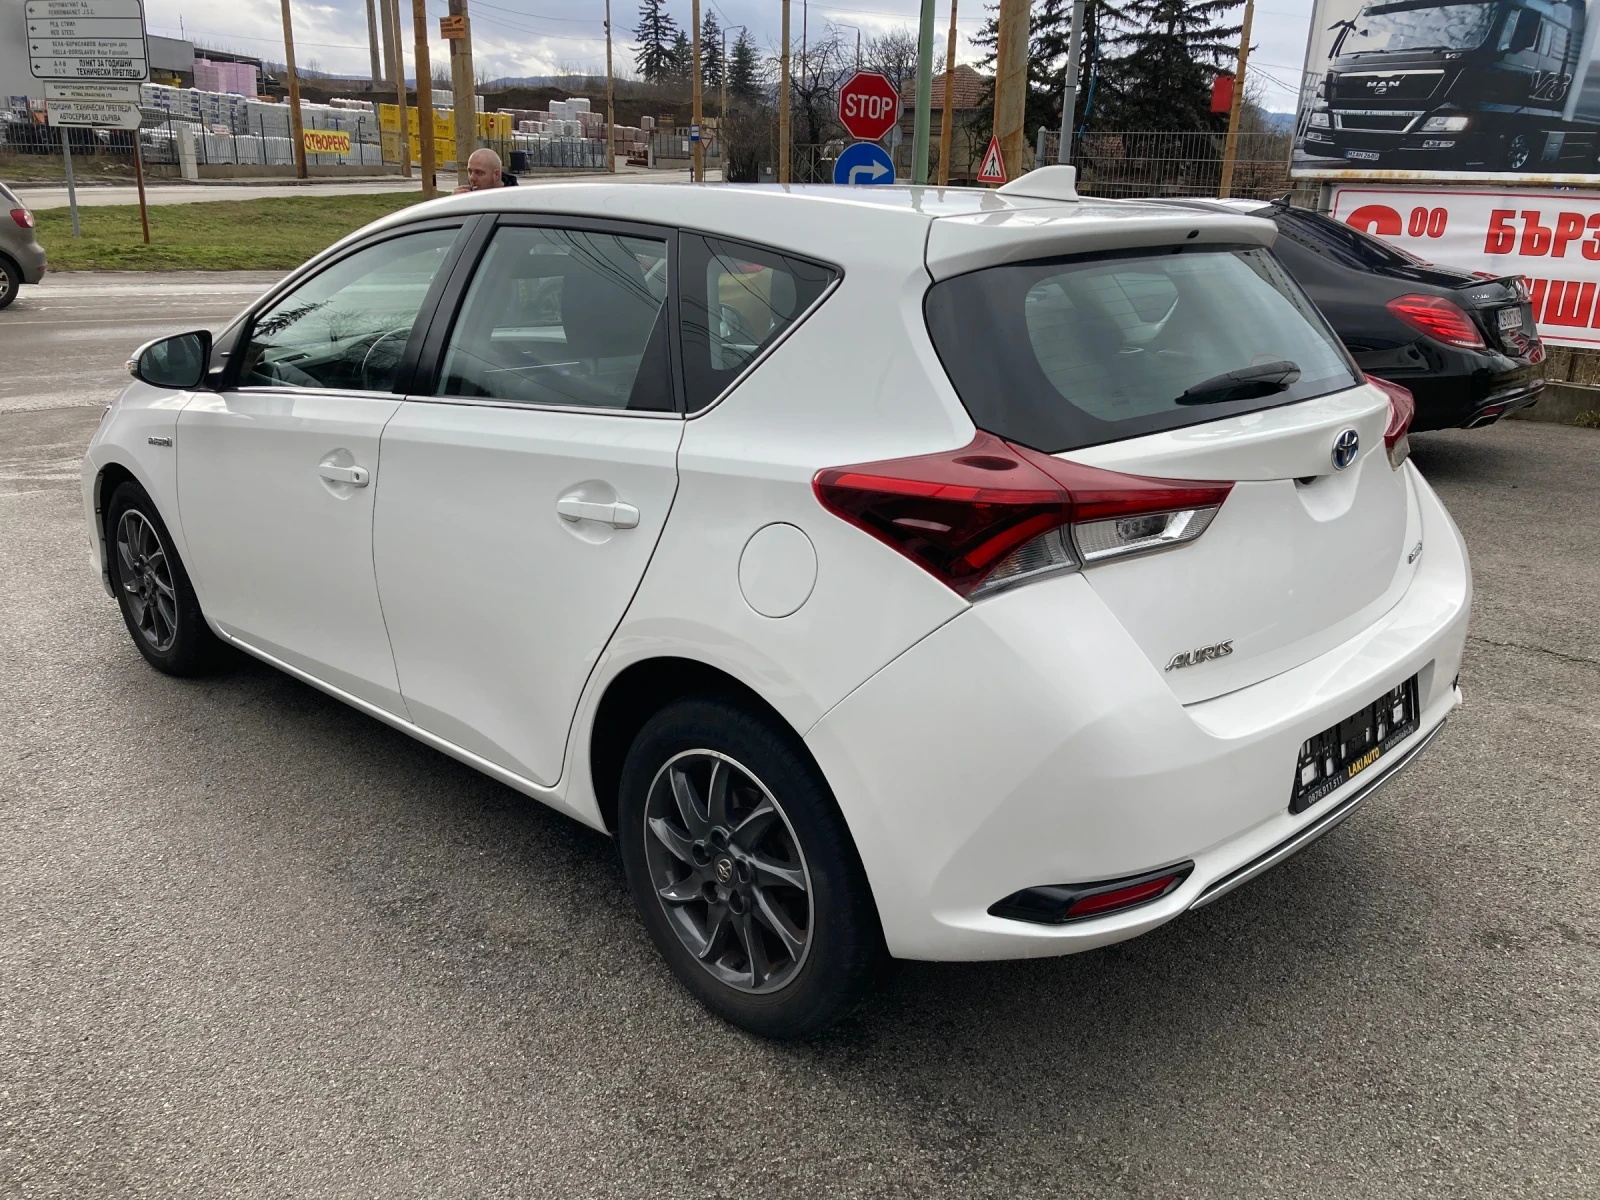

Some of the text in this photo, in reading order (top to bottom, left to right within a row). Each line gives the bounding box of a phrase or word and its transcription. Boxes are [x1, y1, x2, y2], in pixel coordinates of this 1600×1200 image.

[79, 59, 133, 69] ПУНКТ ЗА ГОДИШНИ
[76, 67, 141, 78] ТЕХНИЧЕСКИ ПРЕГЛЕДИ
[1366, 80, 1400, 88] MAN
[73, 103, 105, 112] ТЕХНИЧЕСКИ
[105, 104, 132, 113] ПРЕГЛЕДИ
[845, 93, 893, 120] STOP
[101, 114, 122, 122] ЦЪРКВА
[304, 133, 350, 151] ОТВОРЕНО
[1164, 638, 1234, 672] AURIS
[1308, 775, 1343, 803] 0876 911 511
